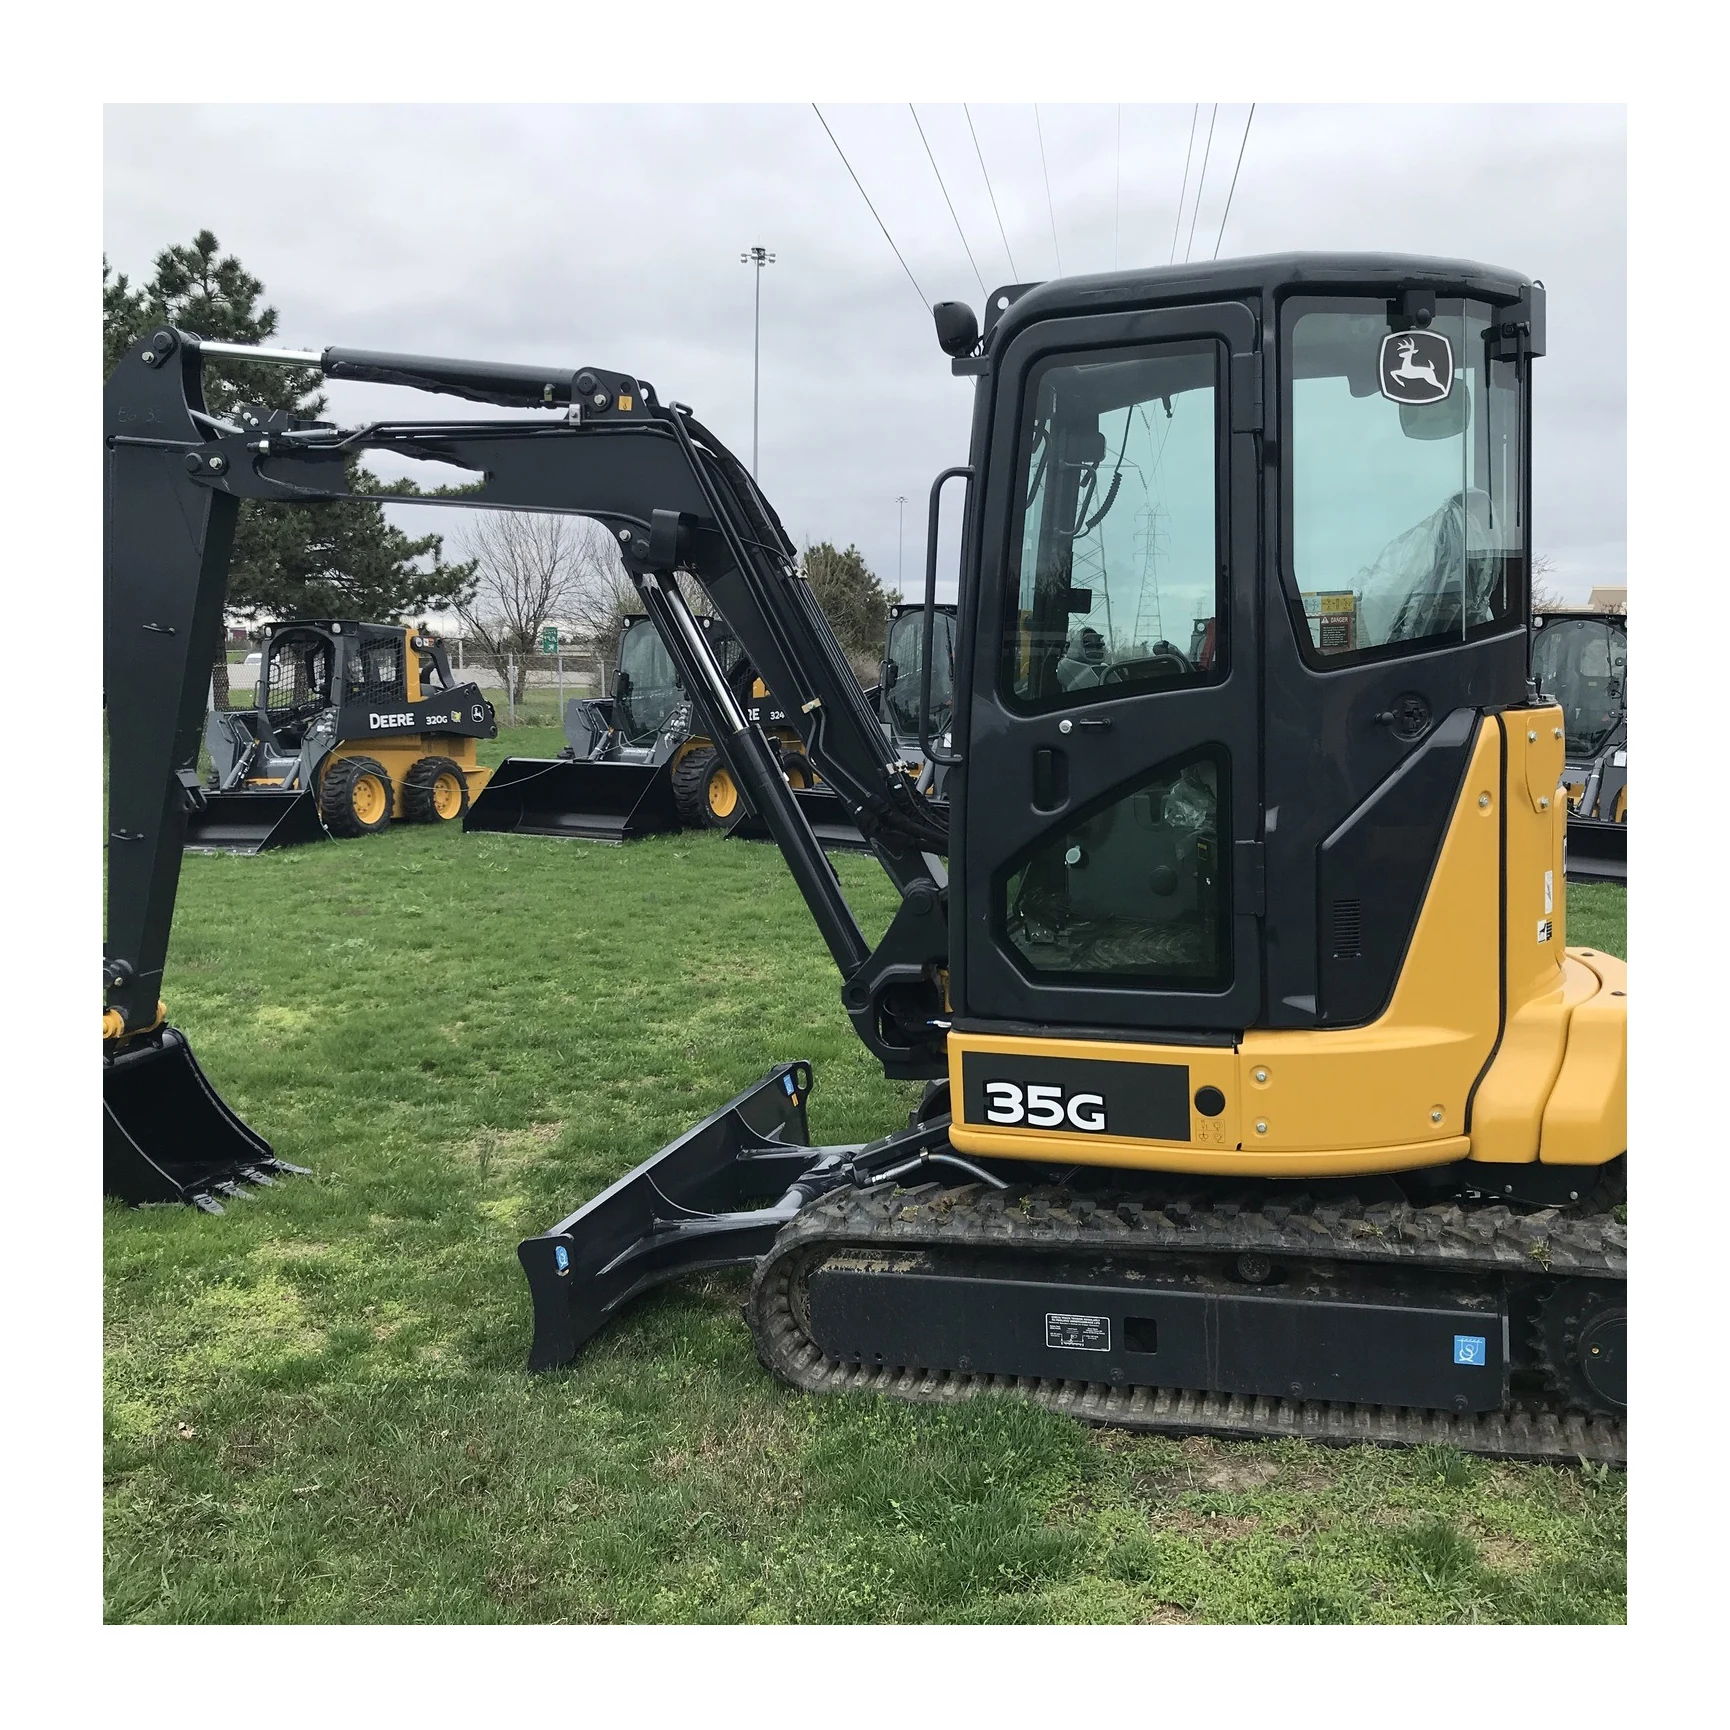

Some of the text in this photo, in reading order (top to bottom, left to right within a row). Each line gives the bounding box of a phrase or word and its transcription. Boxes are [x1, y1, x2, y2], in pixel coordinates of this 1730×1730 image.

[369, 712, 448, 729] DEERE 320G
[985, 1081, 1106, 1131] 35G
